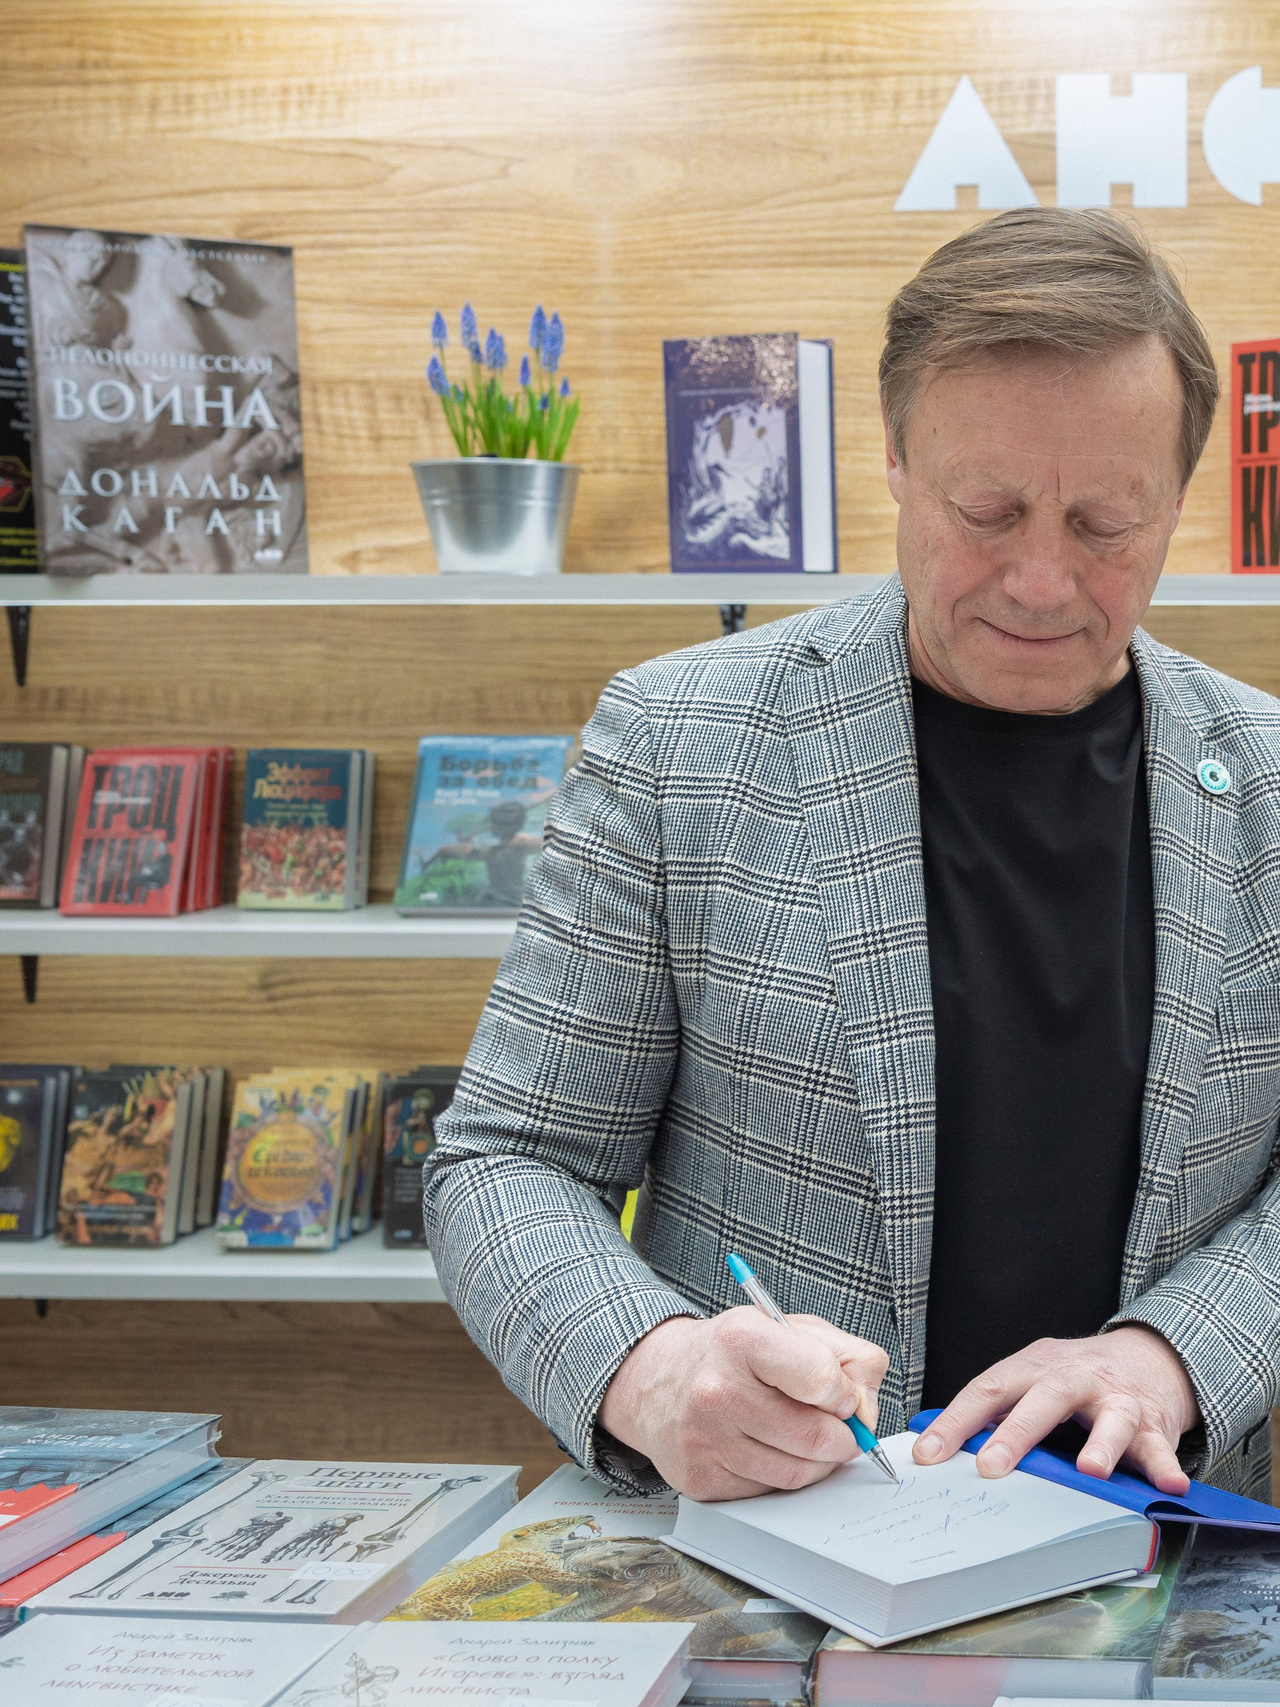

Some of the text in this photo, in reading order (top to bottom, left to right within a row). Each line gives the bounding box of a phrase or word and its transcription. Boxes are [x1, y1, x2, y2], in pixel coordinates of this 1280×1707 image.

[53, 373, 280, 430] ВОЙНА
[58, 468, 282, 502] ДОНАЛЬД
[62, 504, 282, 537] КАГАН
[306, 1467, 442, 1482] Первые
[312, 1479, 407, 1490] шаги
[552, 1501, 653, 1509] УВЛЕКАТЕЛЬНАЯ
[178, 1570, 268, 1580] Джереми
[168, 1577, 257, 1587] Десильва
